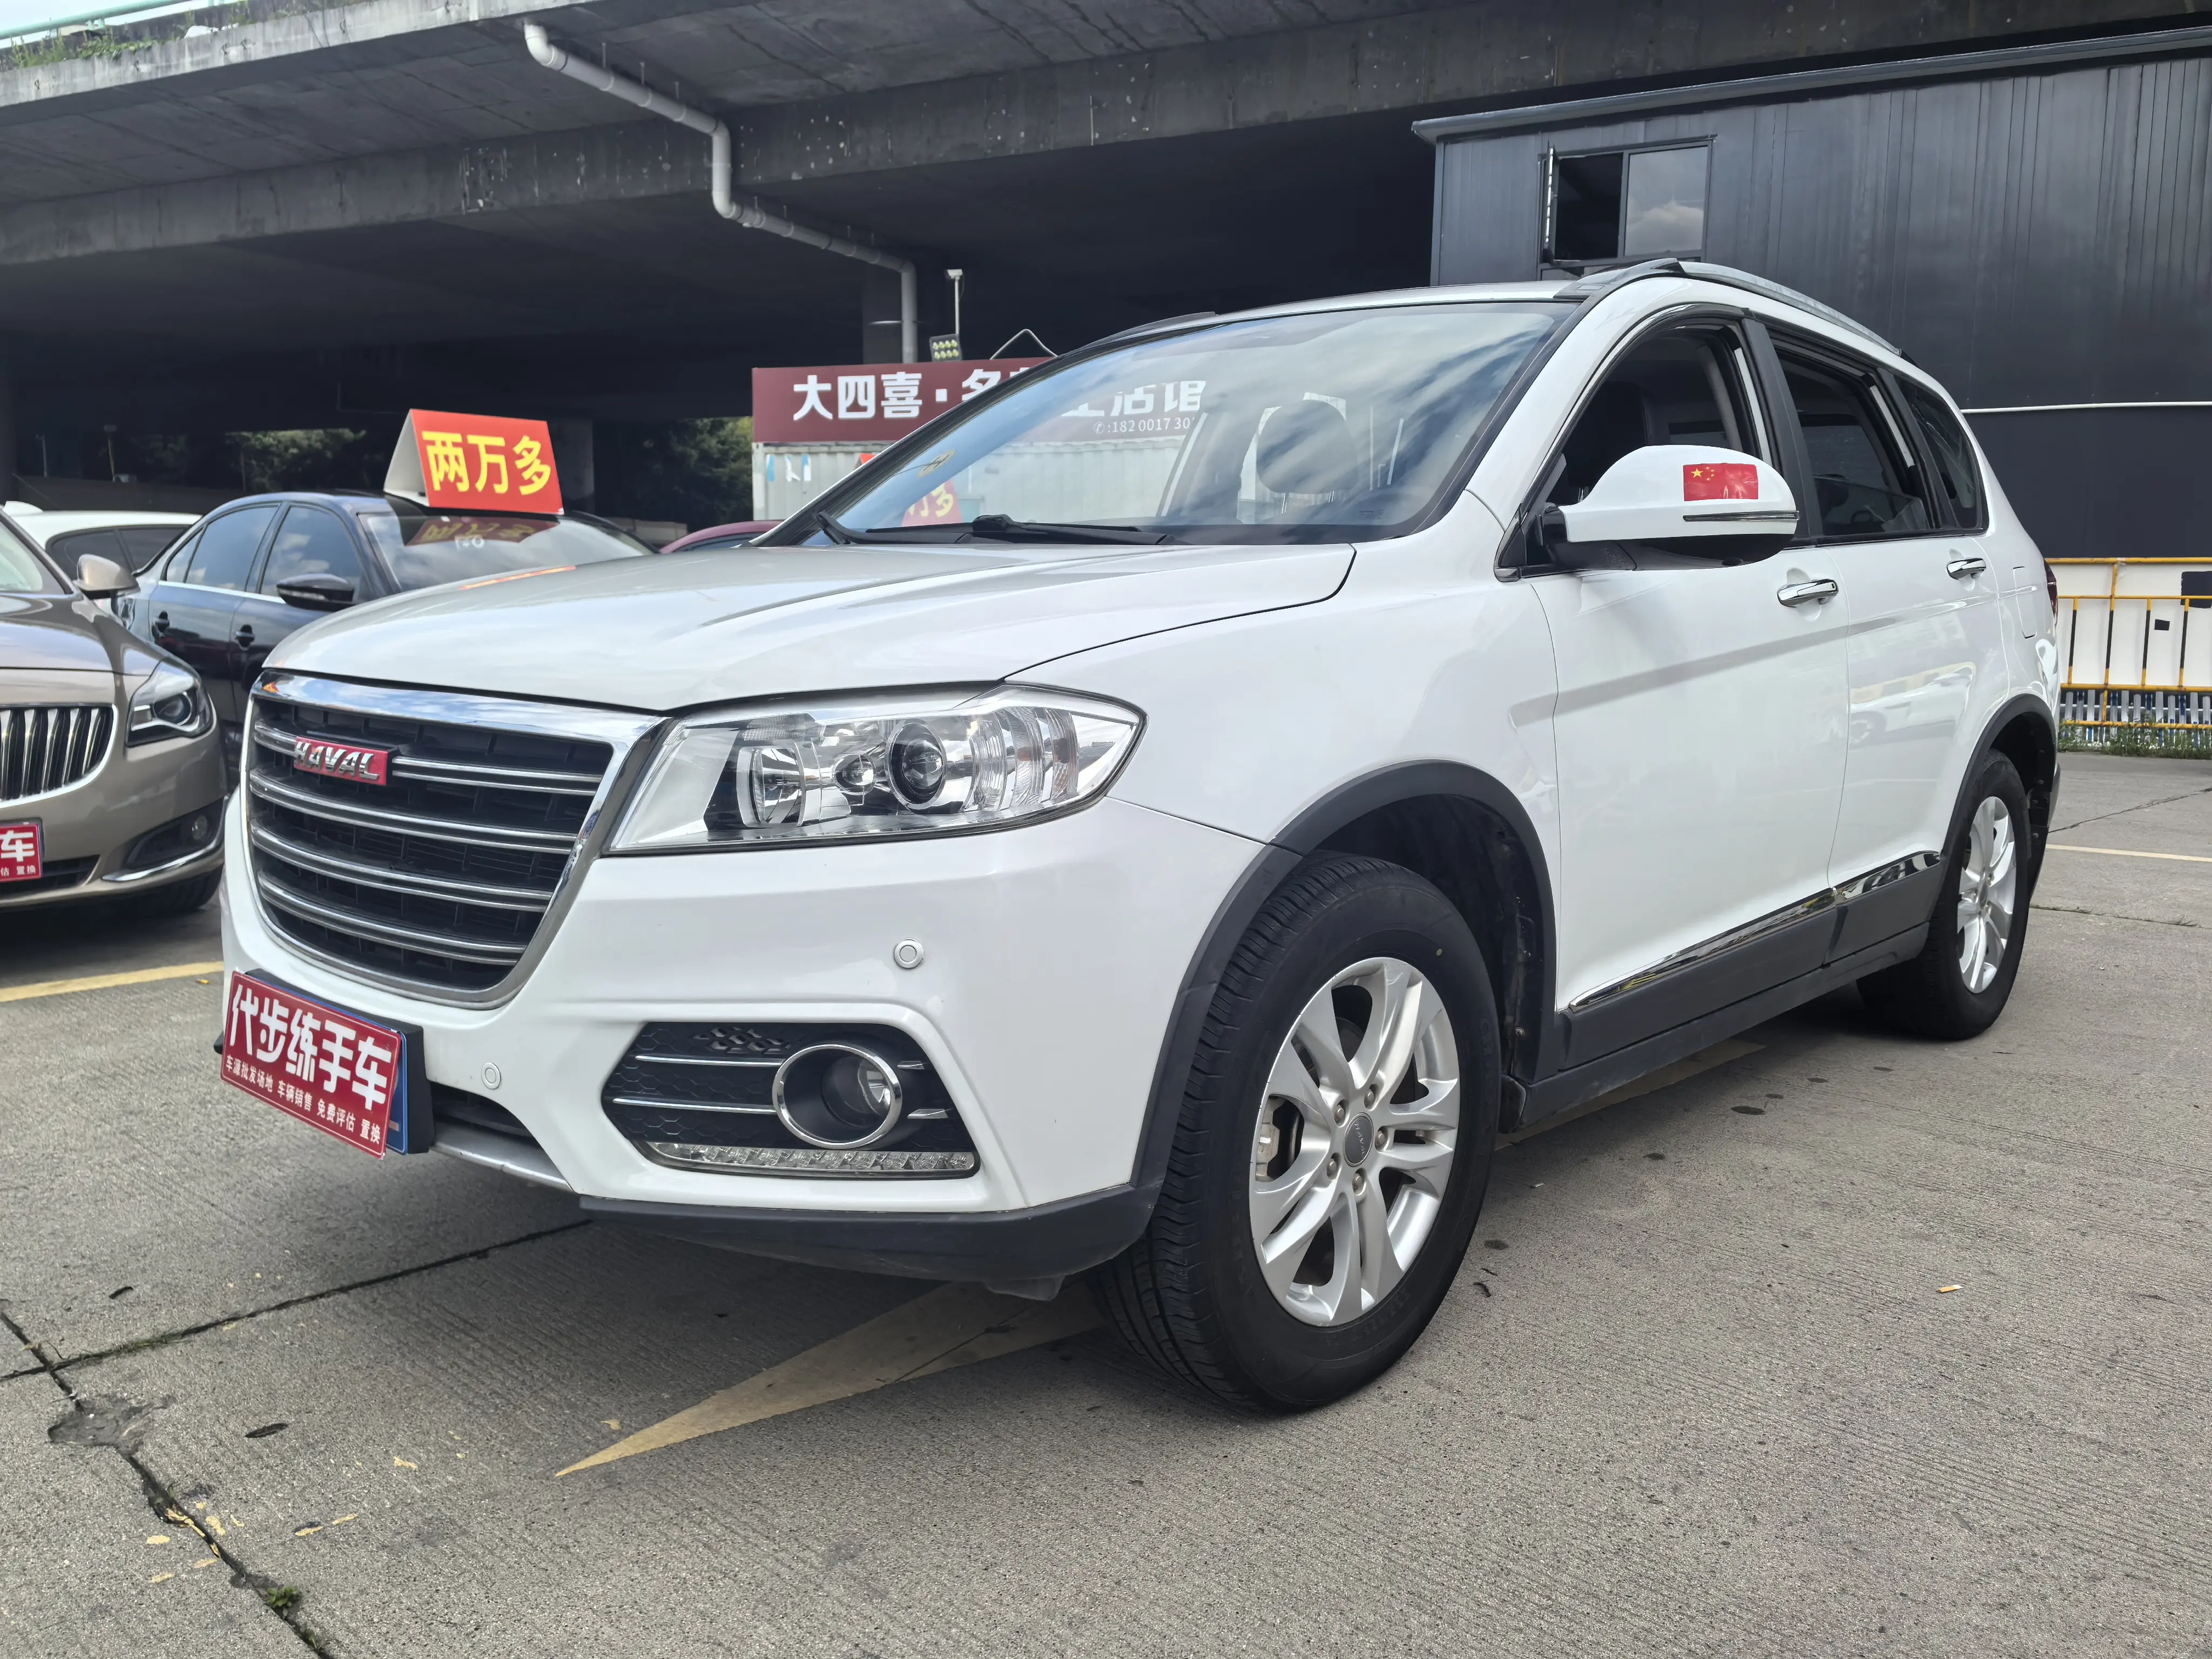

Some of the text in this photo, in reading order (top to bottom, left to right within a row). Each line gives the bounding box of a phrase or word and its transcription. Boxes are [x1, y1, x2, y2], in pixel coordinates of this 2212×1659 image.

[422, 430, 551, 495] 两万多
[295, 741, 380, 780] HAVAL
[0, 830, 35, 862] 车
[230, 983, 392, 1111] 代步练手车
[226, 1054, 381, 1144] 车源批发场地 车辆销售 免费评估 置换
